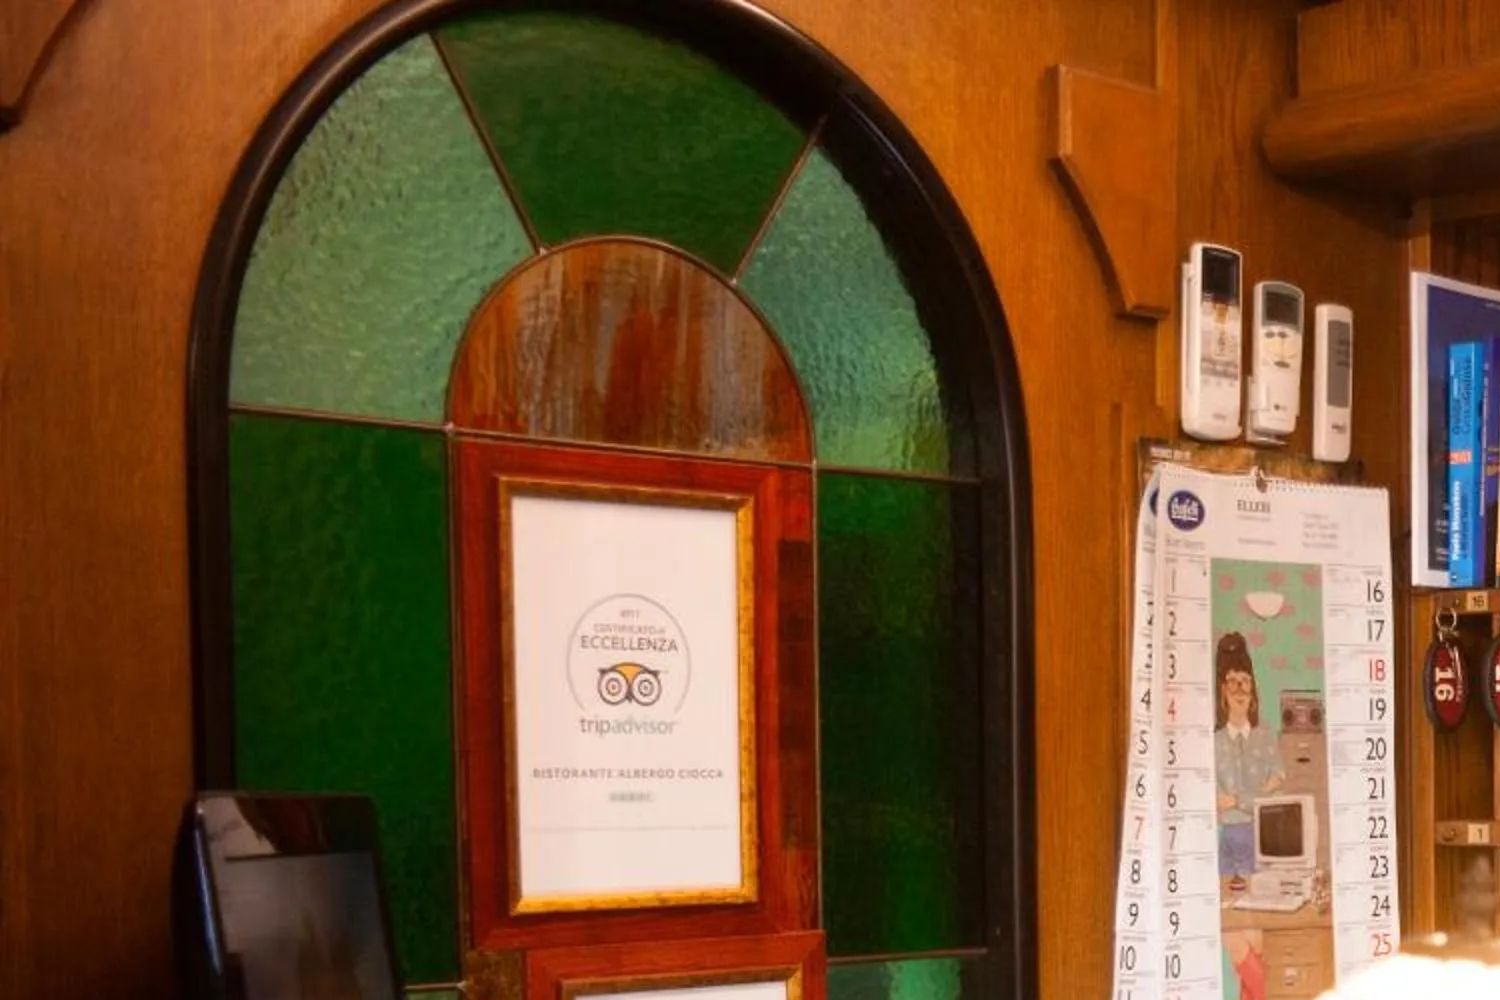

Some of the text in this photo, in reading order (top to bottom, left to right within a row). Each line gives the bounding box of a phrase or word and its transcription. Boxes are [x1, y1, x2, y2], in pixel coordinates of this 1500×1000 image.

[1367, 579, 1385, 603] 16
[1367, 619, 1385, 642] 17
[580, 635, 678, 652] ECCELLENZA
[1369, 659, 1386, 681] 18
[1434, 666, 1455, 702] 16
[1140, 688, 1152, 711] 4
[1167, 698, 1176, 721] 4
[1369, 698, 1387, 721] 19
[580, 717, 675, 738] tripadvisor
[1138, 730, 1148, 754] 5
[1168, 740, 1176, 765] 5
[1365, 737, 1387, 761] 20
[533, 768, 724, 779] RISTORANTE ALBERGO CIOCCA
[1135, 774, 1146, 798] 6
[1167, 784, 1177, 808] 6
[1367, 777, 1385, 800] 21
[1134, 816, 1144, 840] 7
[1168, 826, 1177, 850] 7
[1367, 816, 1389, 839] 22
[1477, 829, 1484, 840] 1
[1130, 859, 1141, 884] 8
[1370, 855, 1389, 878] 23
[1167, 869, 1178, 893] 8
[1128, 903, 1139, 927] 9
[1371, 895, 1390, 917] 24
[1169, 911, 1180, 936] 9
[1371, 933, 1392, 957] 25
[1120, 945, 1136, 970] 10
[1165, 953, 1181, 978] 10
